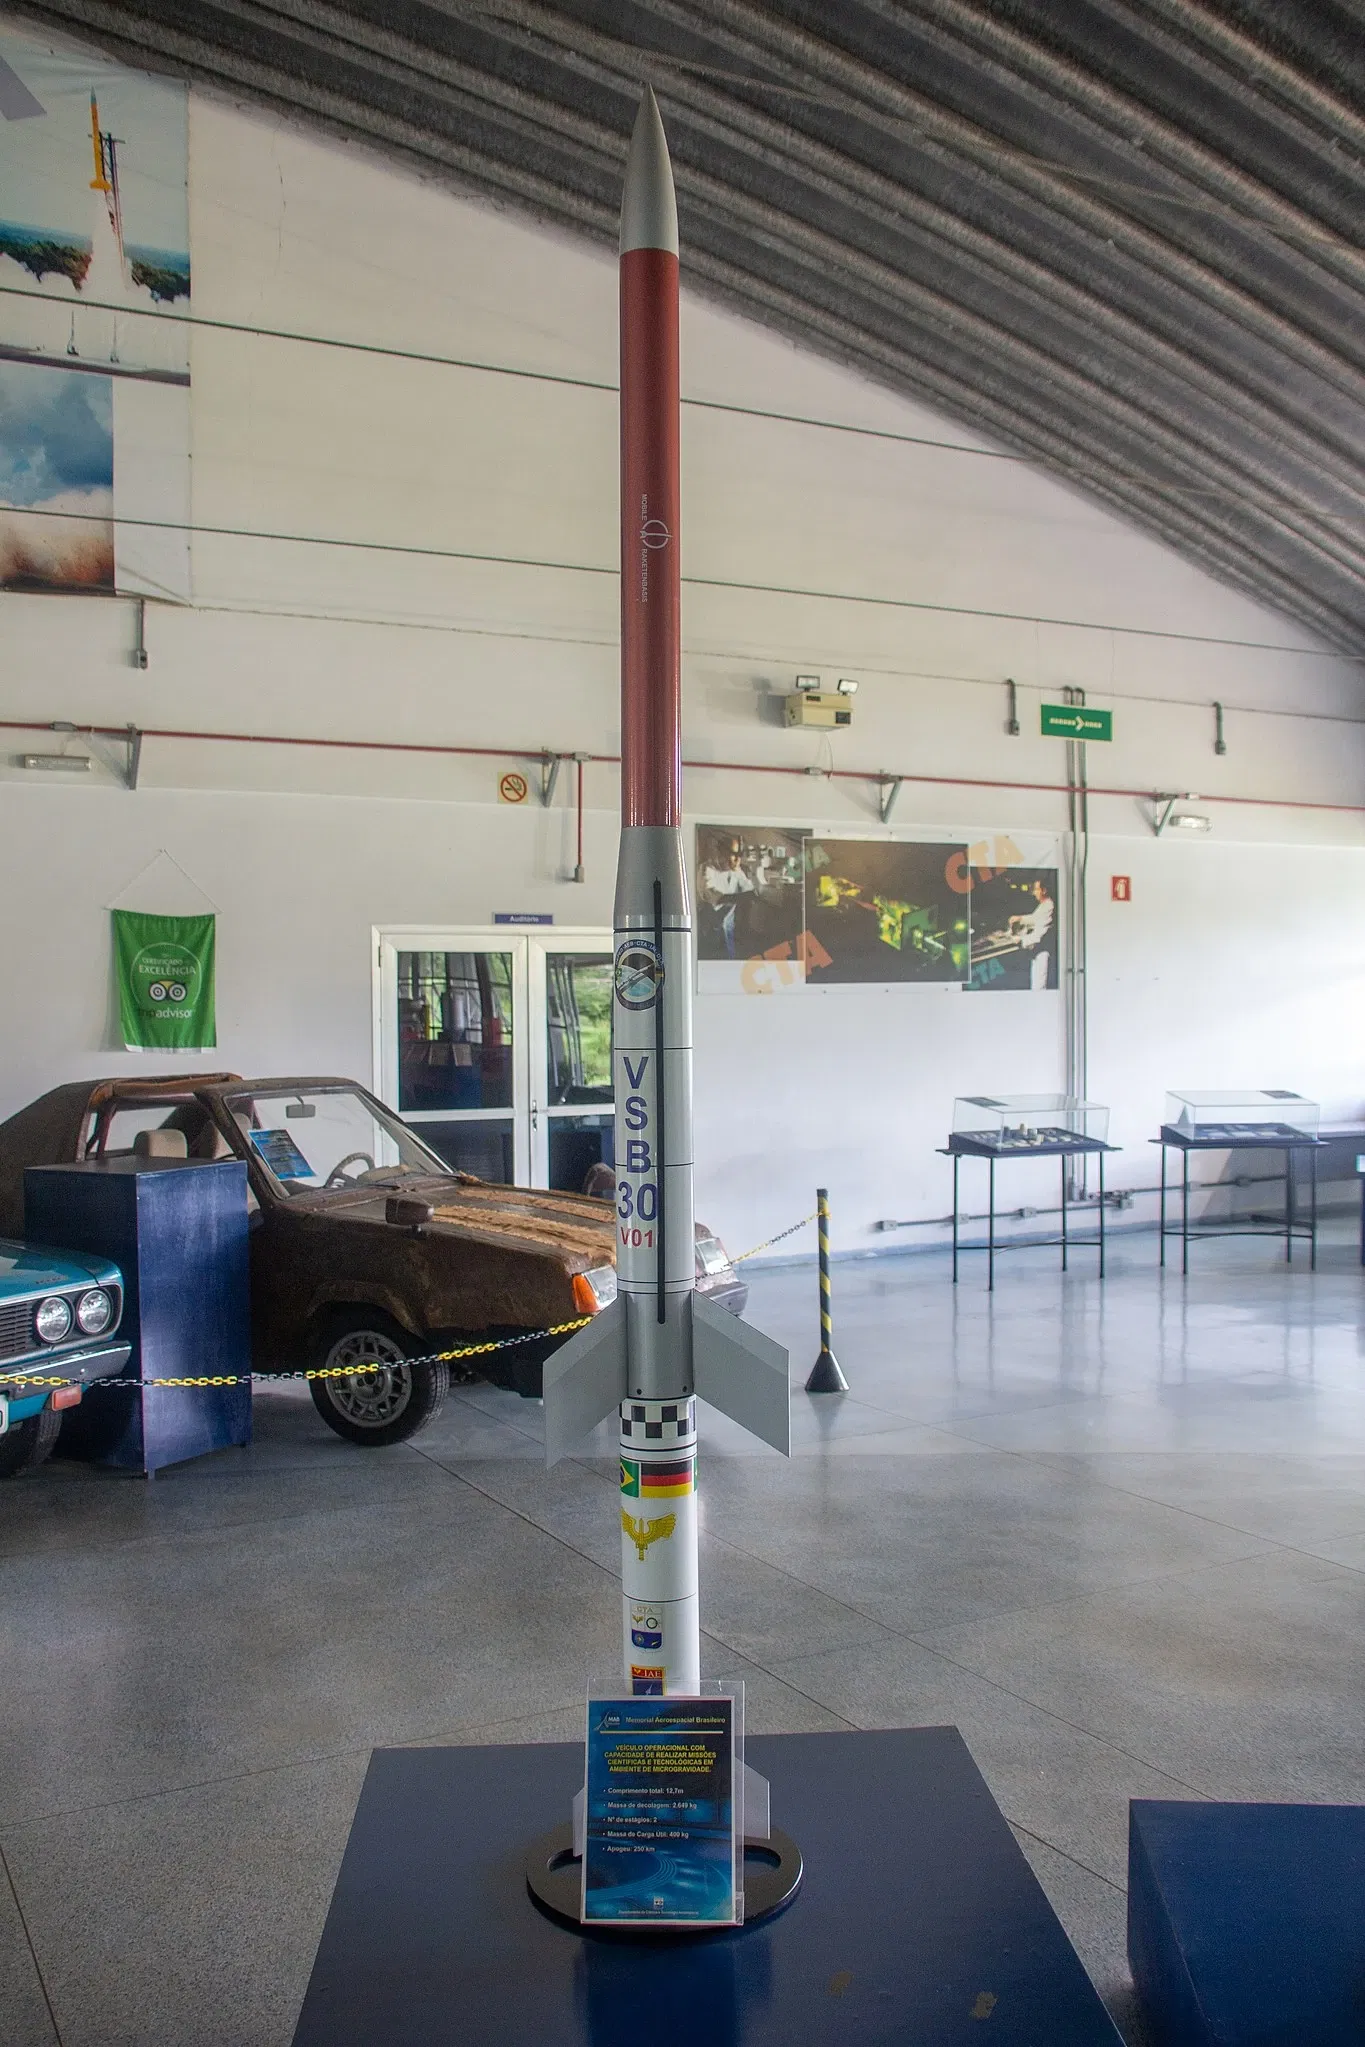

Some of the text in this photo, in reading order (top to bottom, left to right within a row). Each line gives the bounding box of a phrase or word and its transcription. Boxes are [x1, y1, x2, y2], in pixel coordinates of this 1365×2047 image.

[945, 835, 1025, 894] CTA
[741, 930, 833, 995] CTA
[617, 1180, 658, 1222] 30
[620, 1226, 654, 1249] V01
[644, 1670, 661, 1678] IAE
[625, 1716, 726, 1725] Memorial Aeroespacial Brasileiro
[607, 1787, 648, 1795] Comprimento
[636, 1831, 655, 1839] Carga
[681, 1831, 689, 1839] kg
[607, 1845, 632, 1853] Apogeu:
